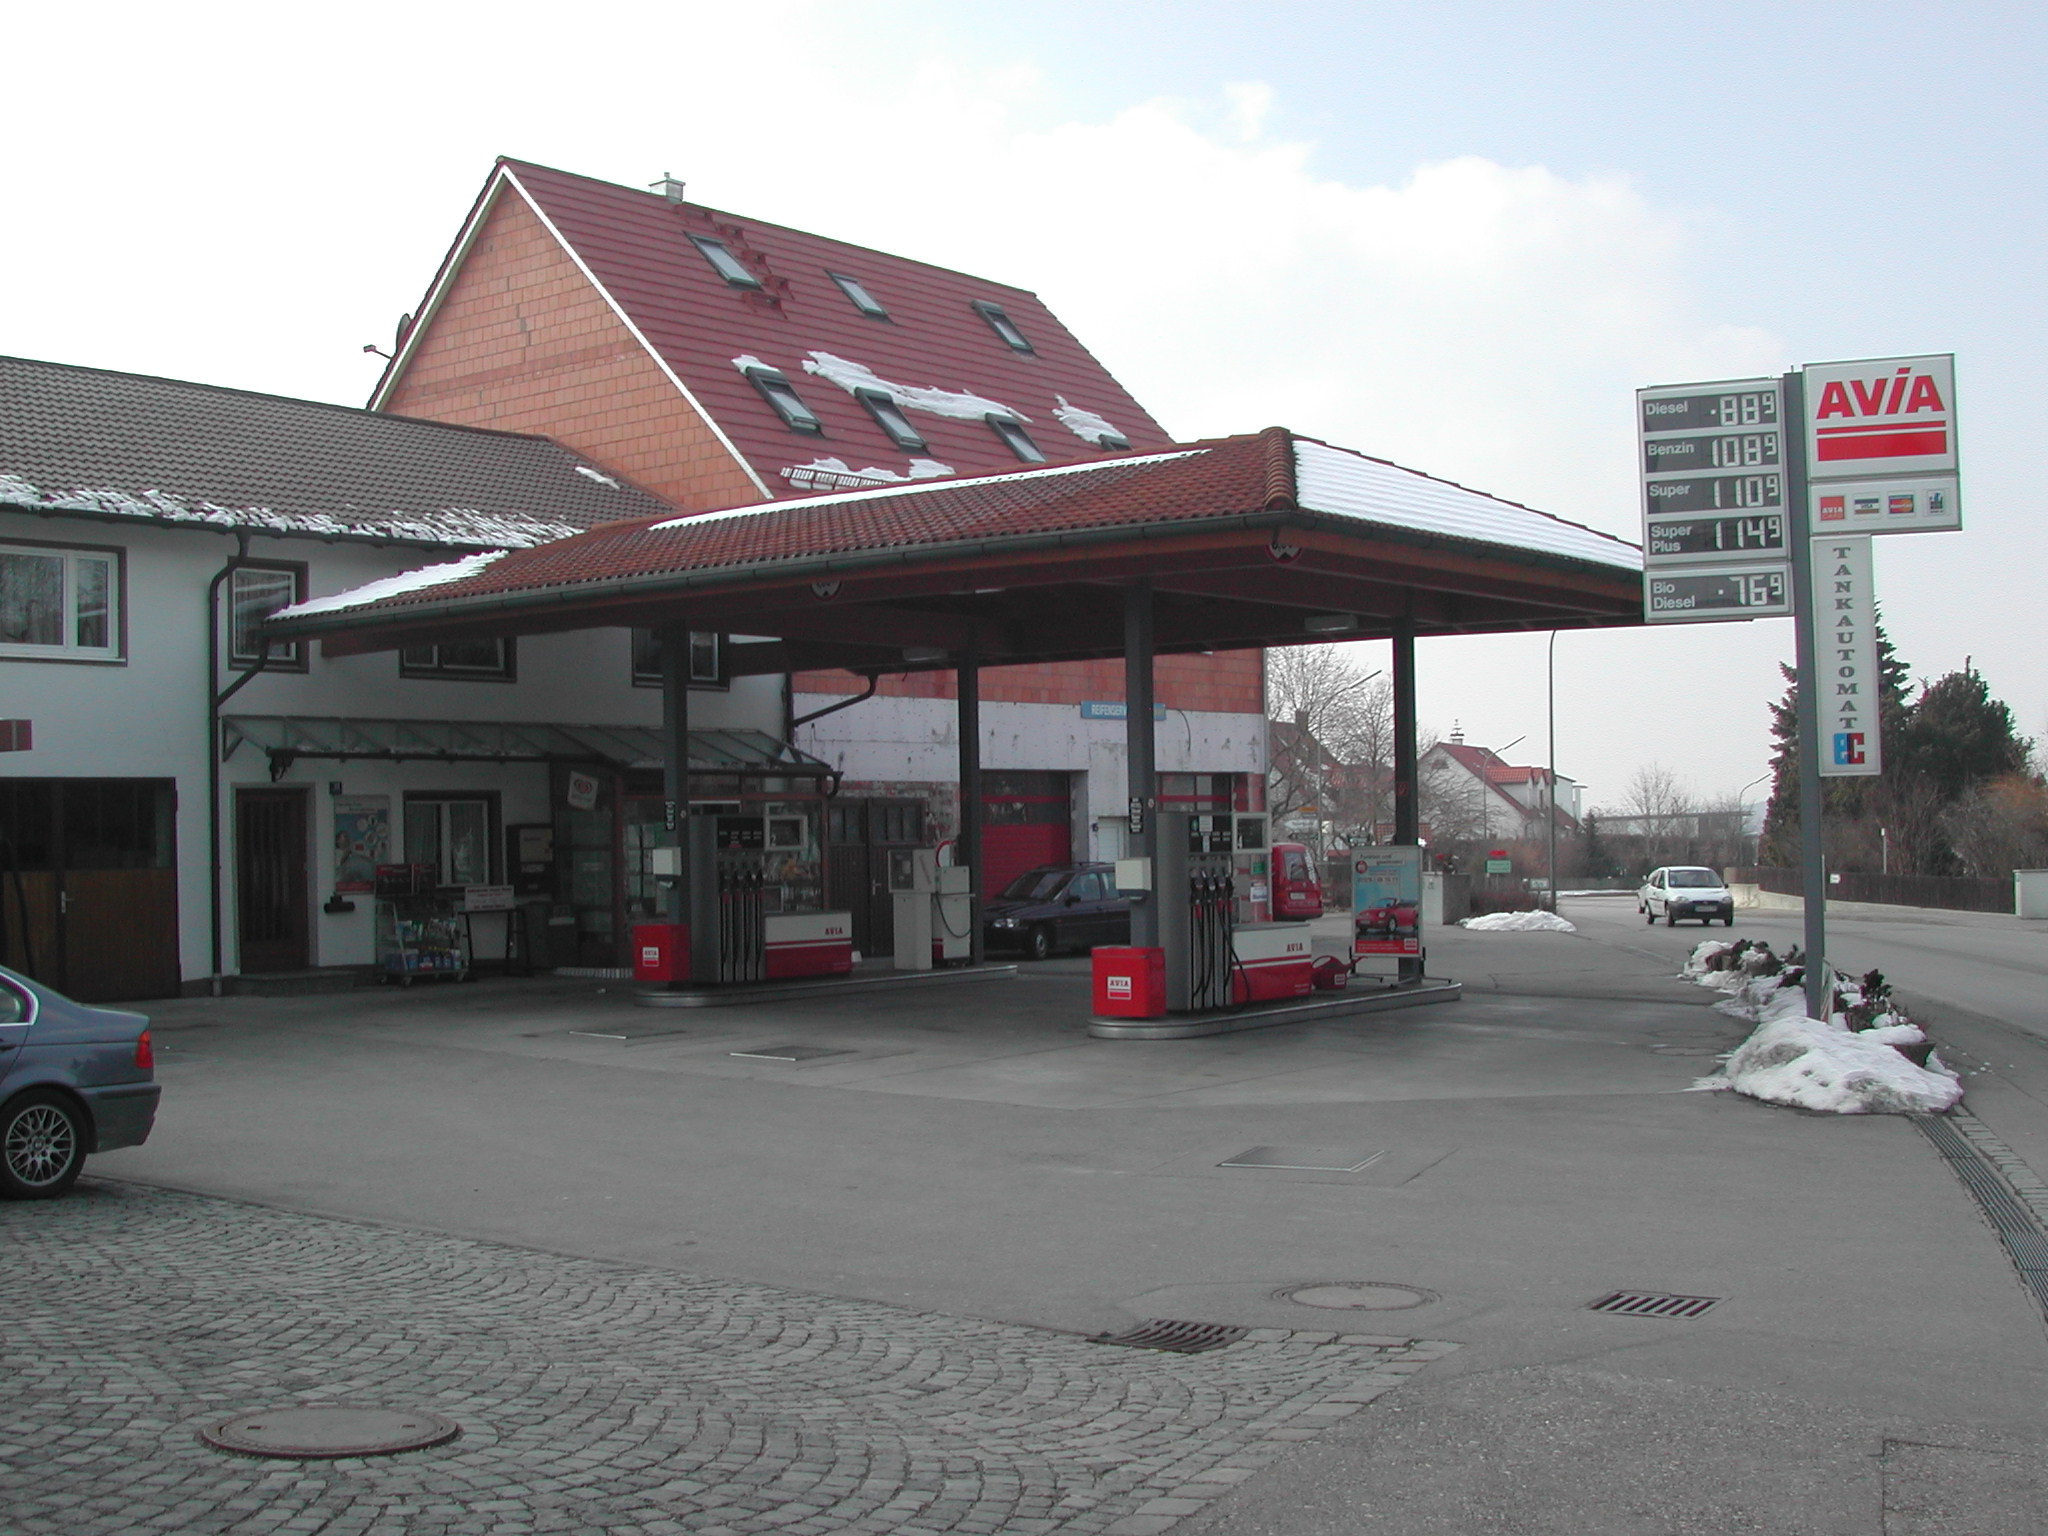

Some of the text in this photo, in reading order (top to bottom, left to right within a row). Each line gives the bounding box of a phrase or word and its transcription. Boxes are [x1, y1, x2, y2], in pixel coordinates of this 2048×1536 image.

[1645, 402, 1688, 415] Diesel
[1816, 367, 1946, 420] AVIA
[1647, 434, 1777, 467] Benzin 1089
[1649, 476, 1779, 509] Super 1109
[1650, 525, 1692, 539] Super
[1651, 517, 1781, 553] Plus 1149
[1653, 582, 1675, 594] Bio
[1653, 595, 1696, 610] Diesel
[1833, 546, 1859, 729] TANKAUTOMAT
